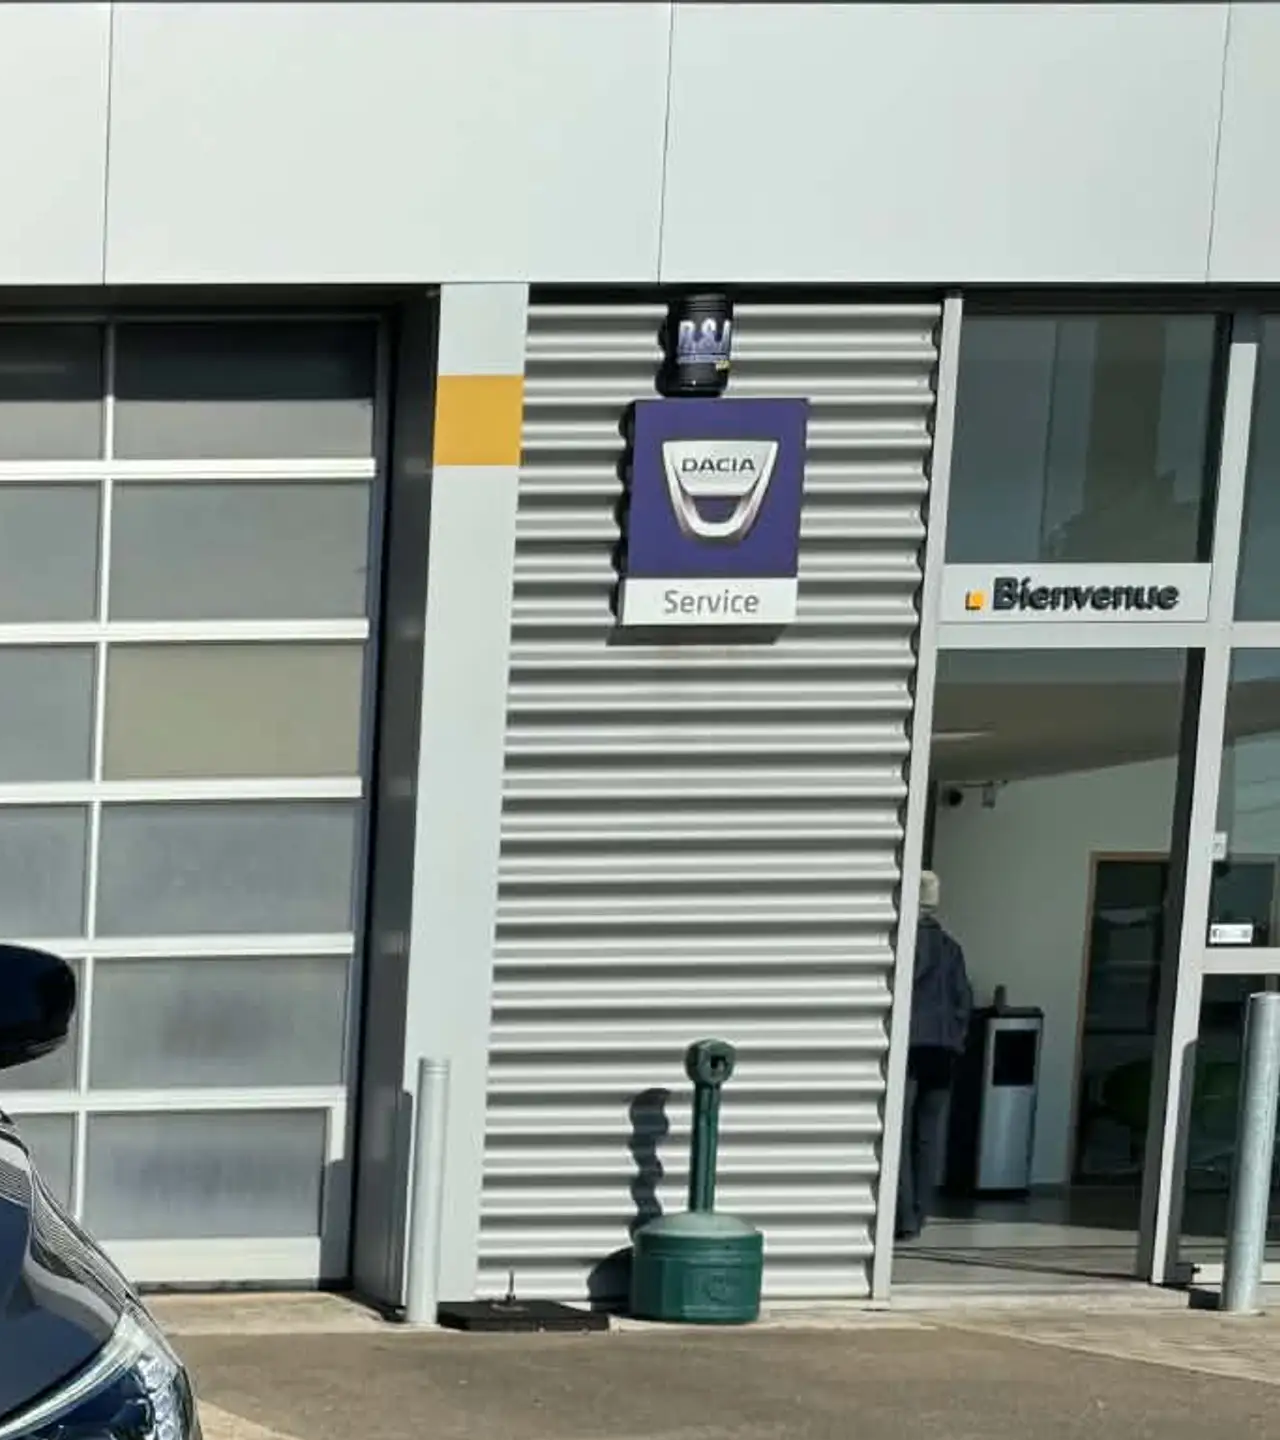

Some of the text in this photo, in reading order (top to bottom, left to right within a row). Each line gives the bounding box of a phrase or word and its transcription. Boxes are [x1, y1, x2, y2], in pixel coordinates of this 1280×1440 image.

[681, 457, 756, 473] DACIA
[664, 590, 760, 615] Service
[992, 577, 1180, 612] Bienvenue
